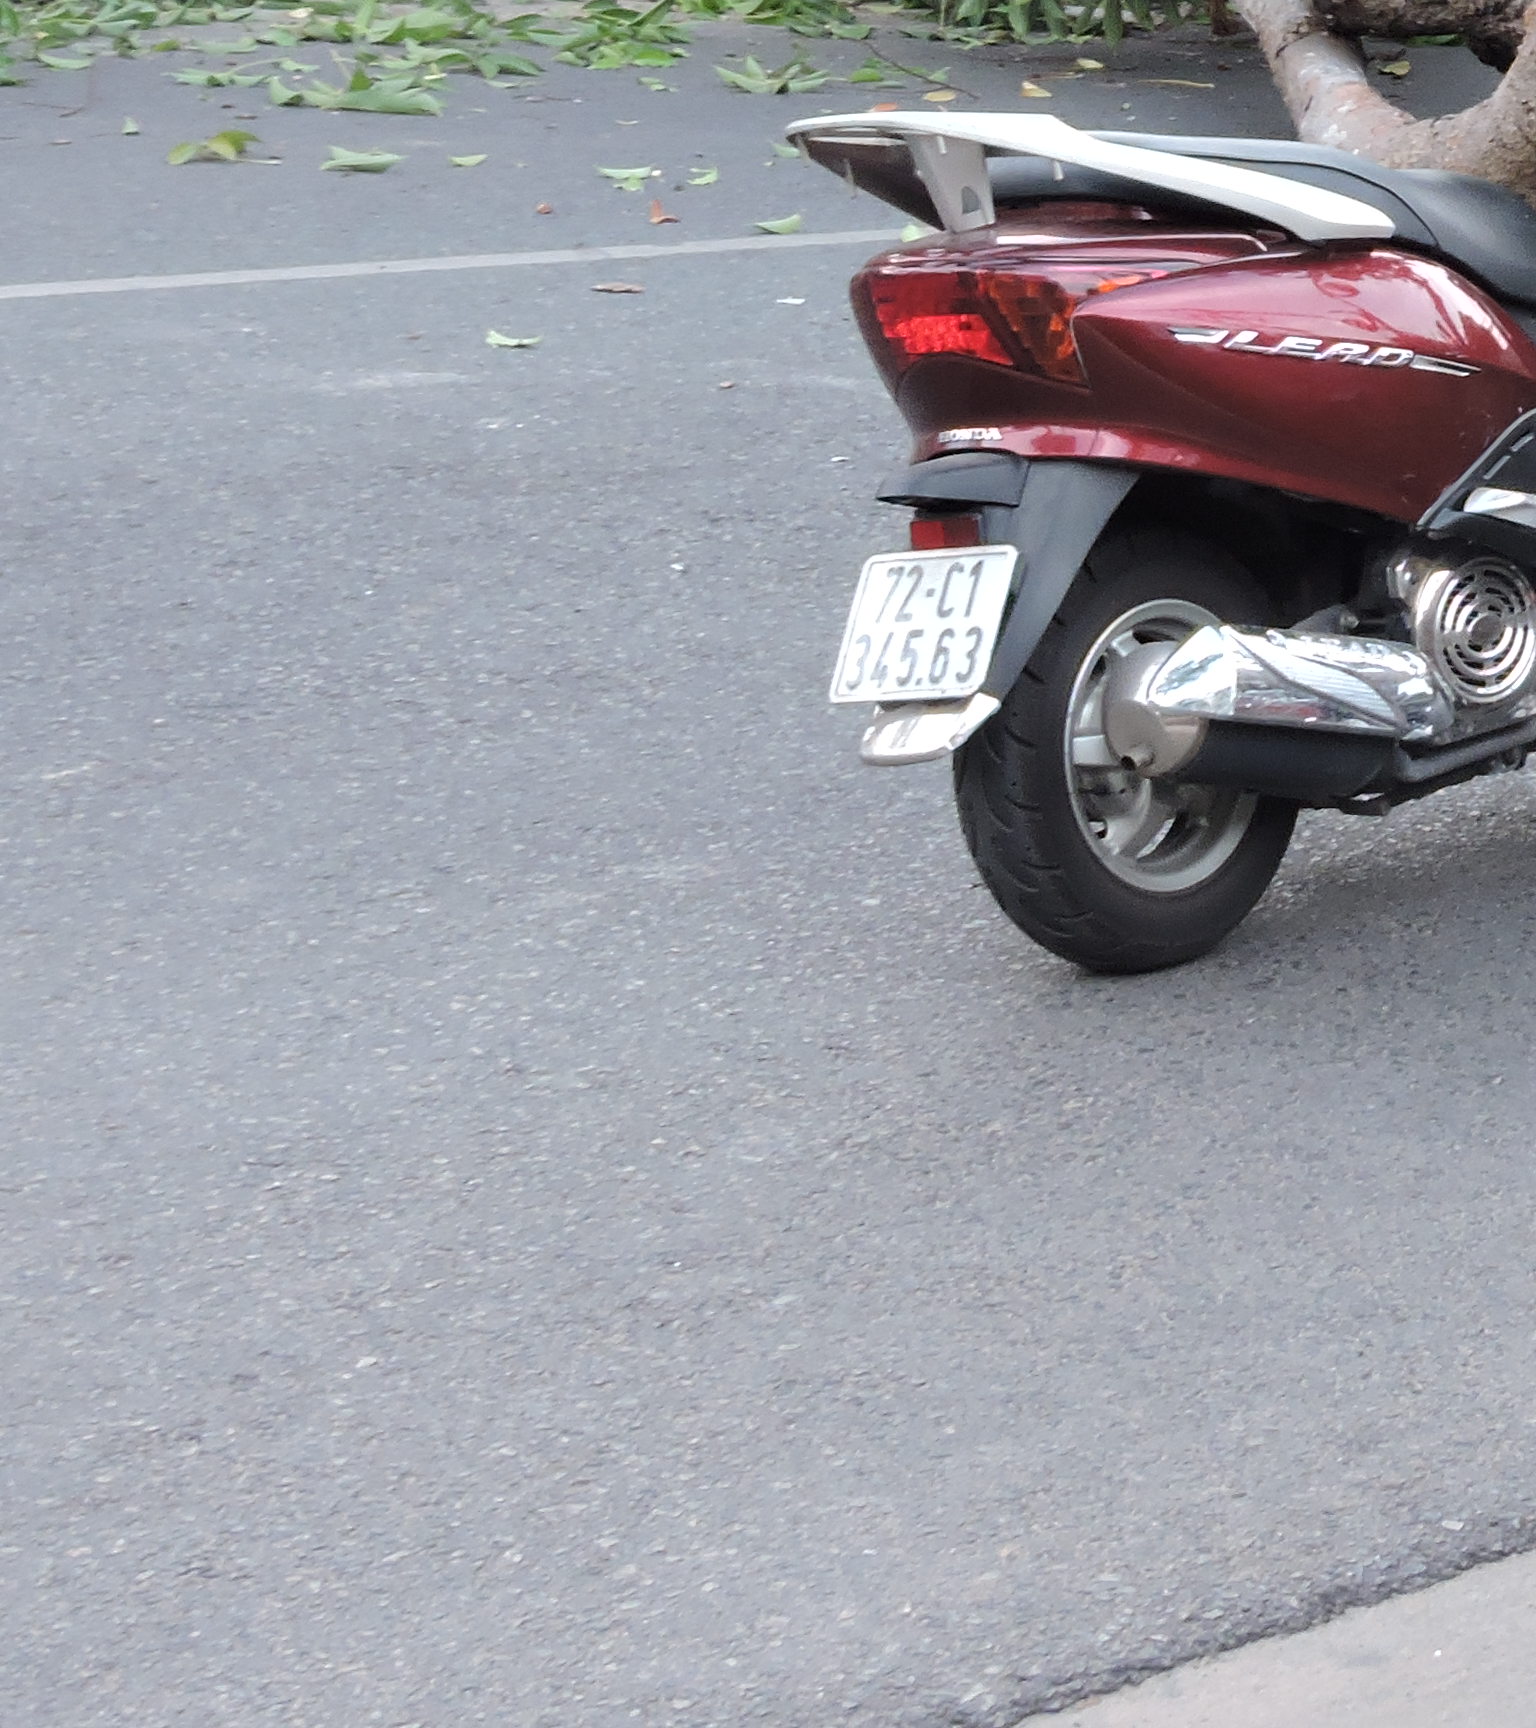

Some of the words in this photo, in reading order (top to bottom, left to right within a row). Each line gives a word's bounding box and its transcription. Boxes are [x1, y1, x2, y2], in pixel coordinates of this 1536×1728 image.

[1223, 329, 1415, 367] LEAD
[876, 560, 984, 623] 72-C1
[845, 626, 984, 691] 345.63
